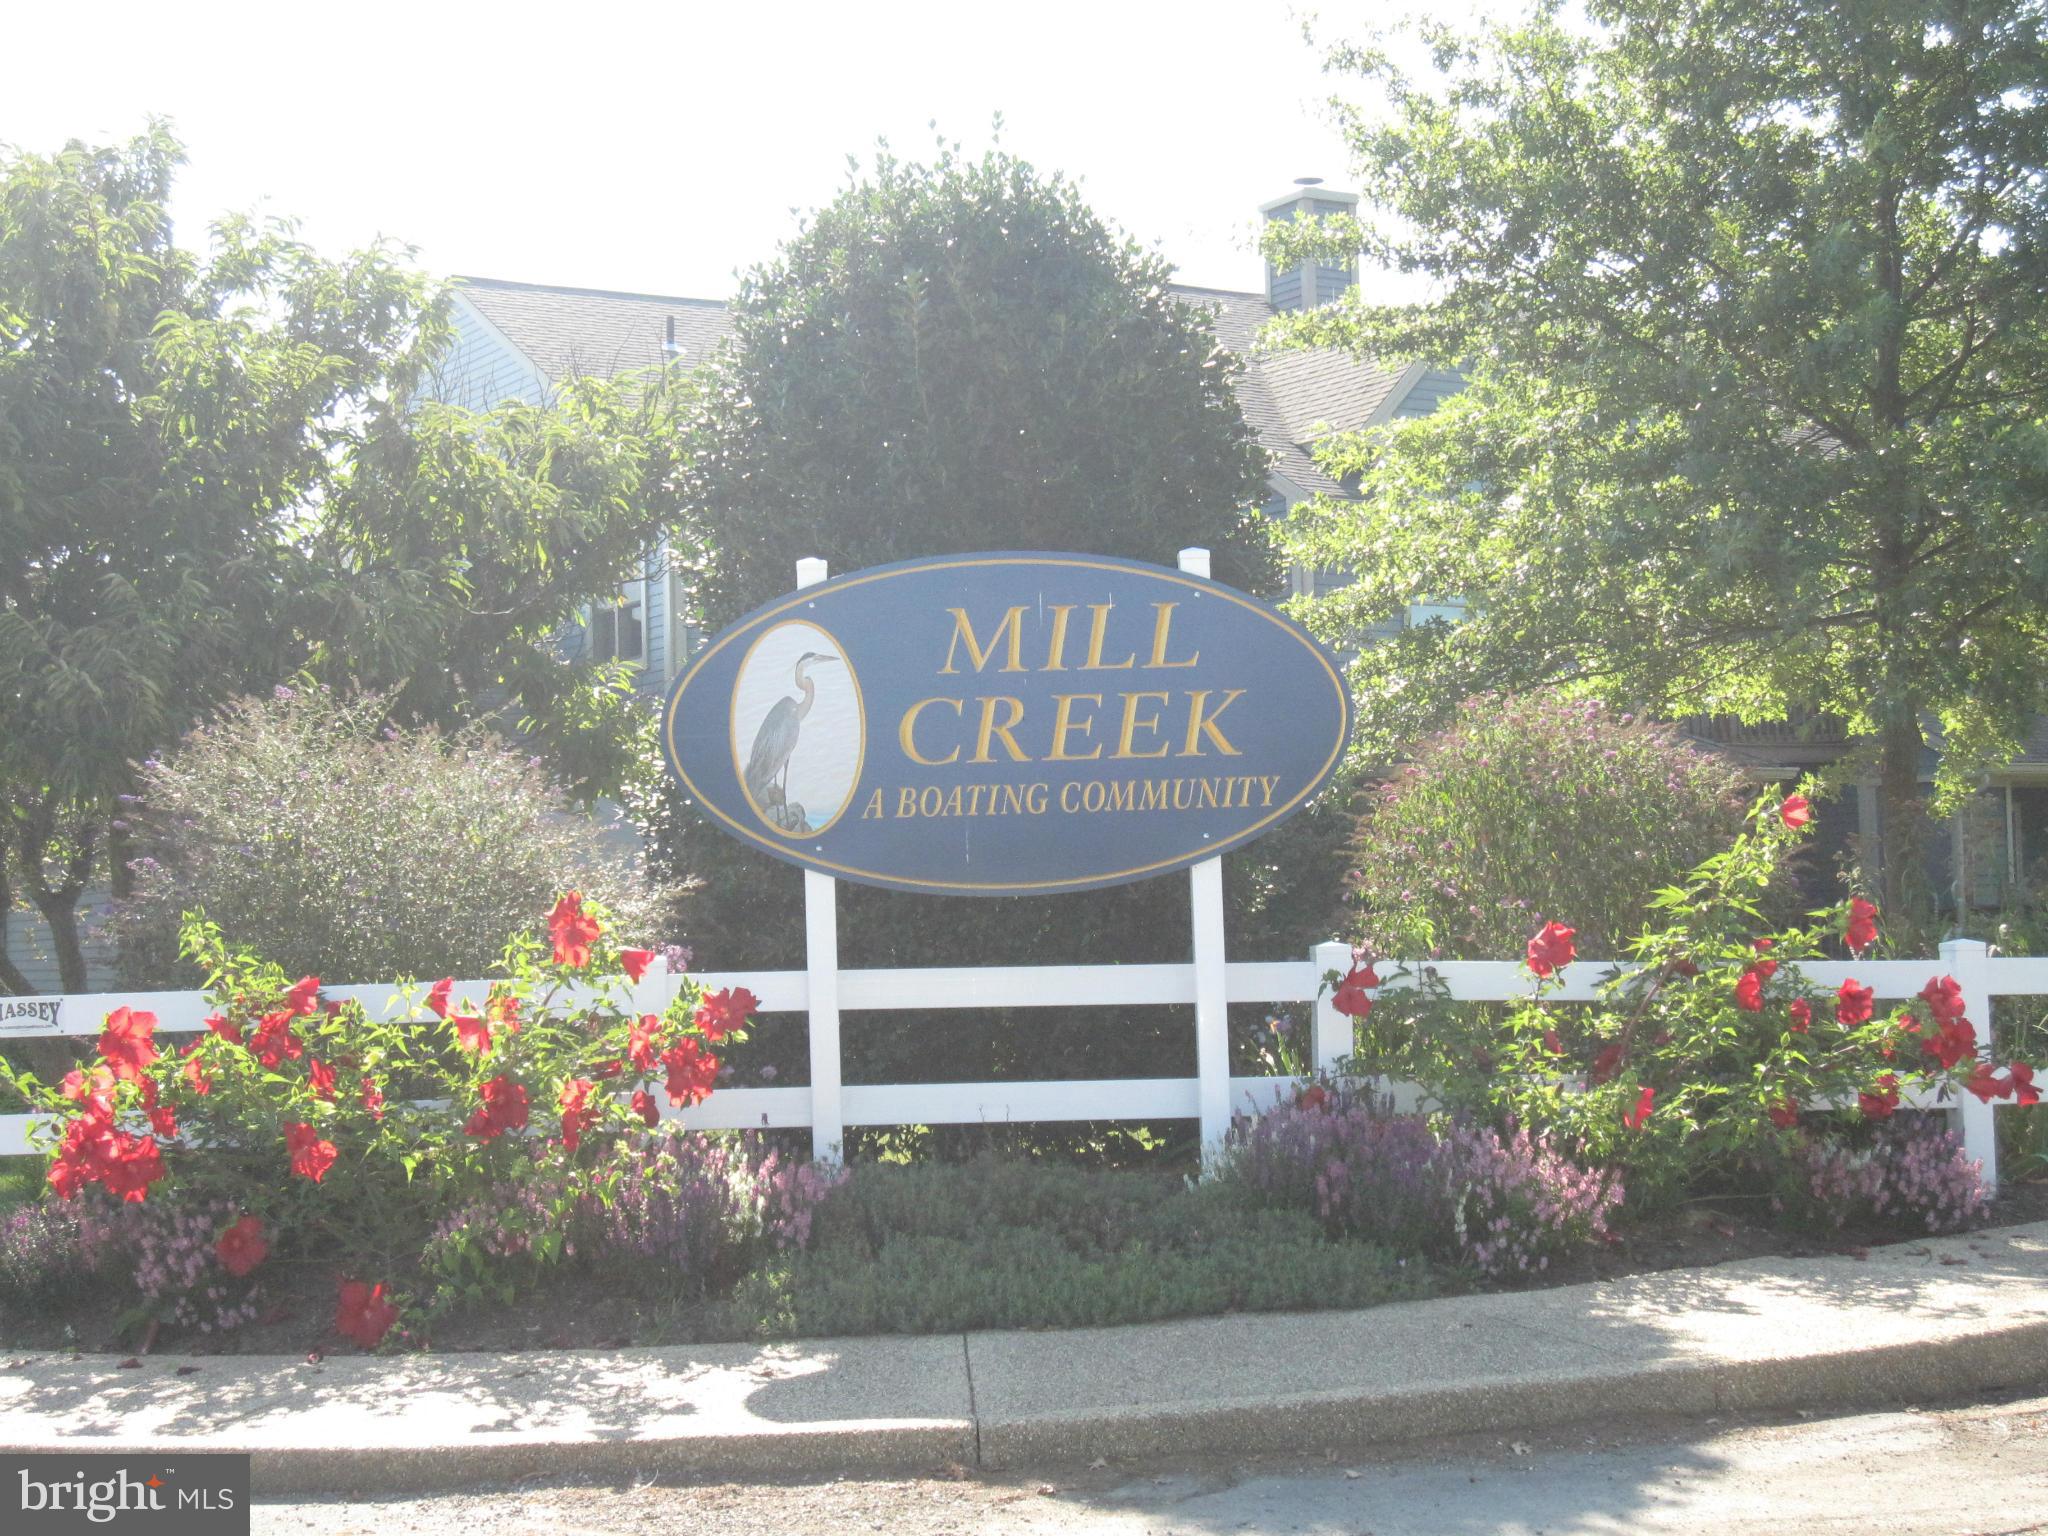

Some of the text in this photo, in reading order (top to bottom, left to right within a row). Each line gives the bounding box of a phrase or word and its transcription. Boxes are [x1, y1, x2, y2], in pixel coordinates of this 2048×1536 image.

[937, 602, 1200, 674] MILL
[899, 688, 1248, 766] CREEK
[862, 775, 1281, 819] A BOATING COMMUNITY
